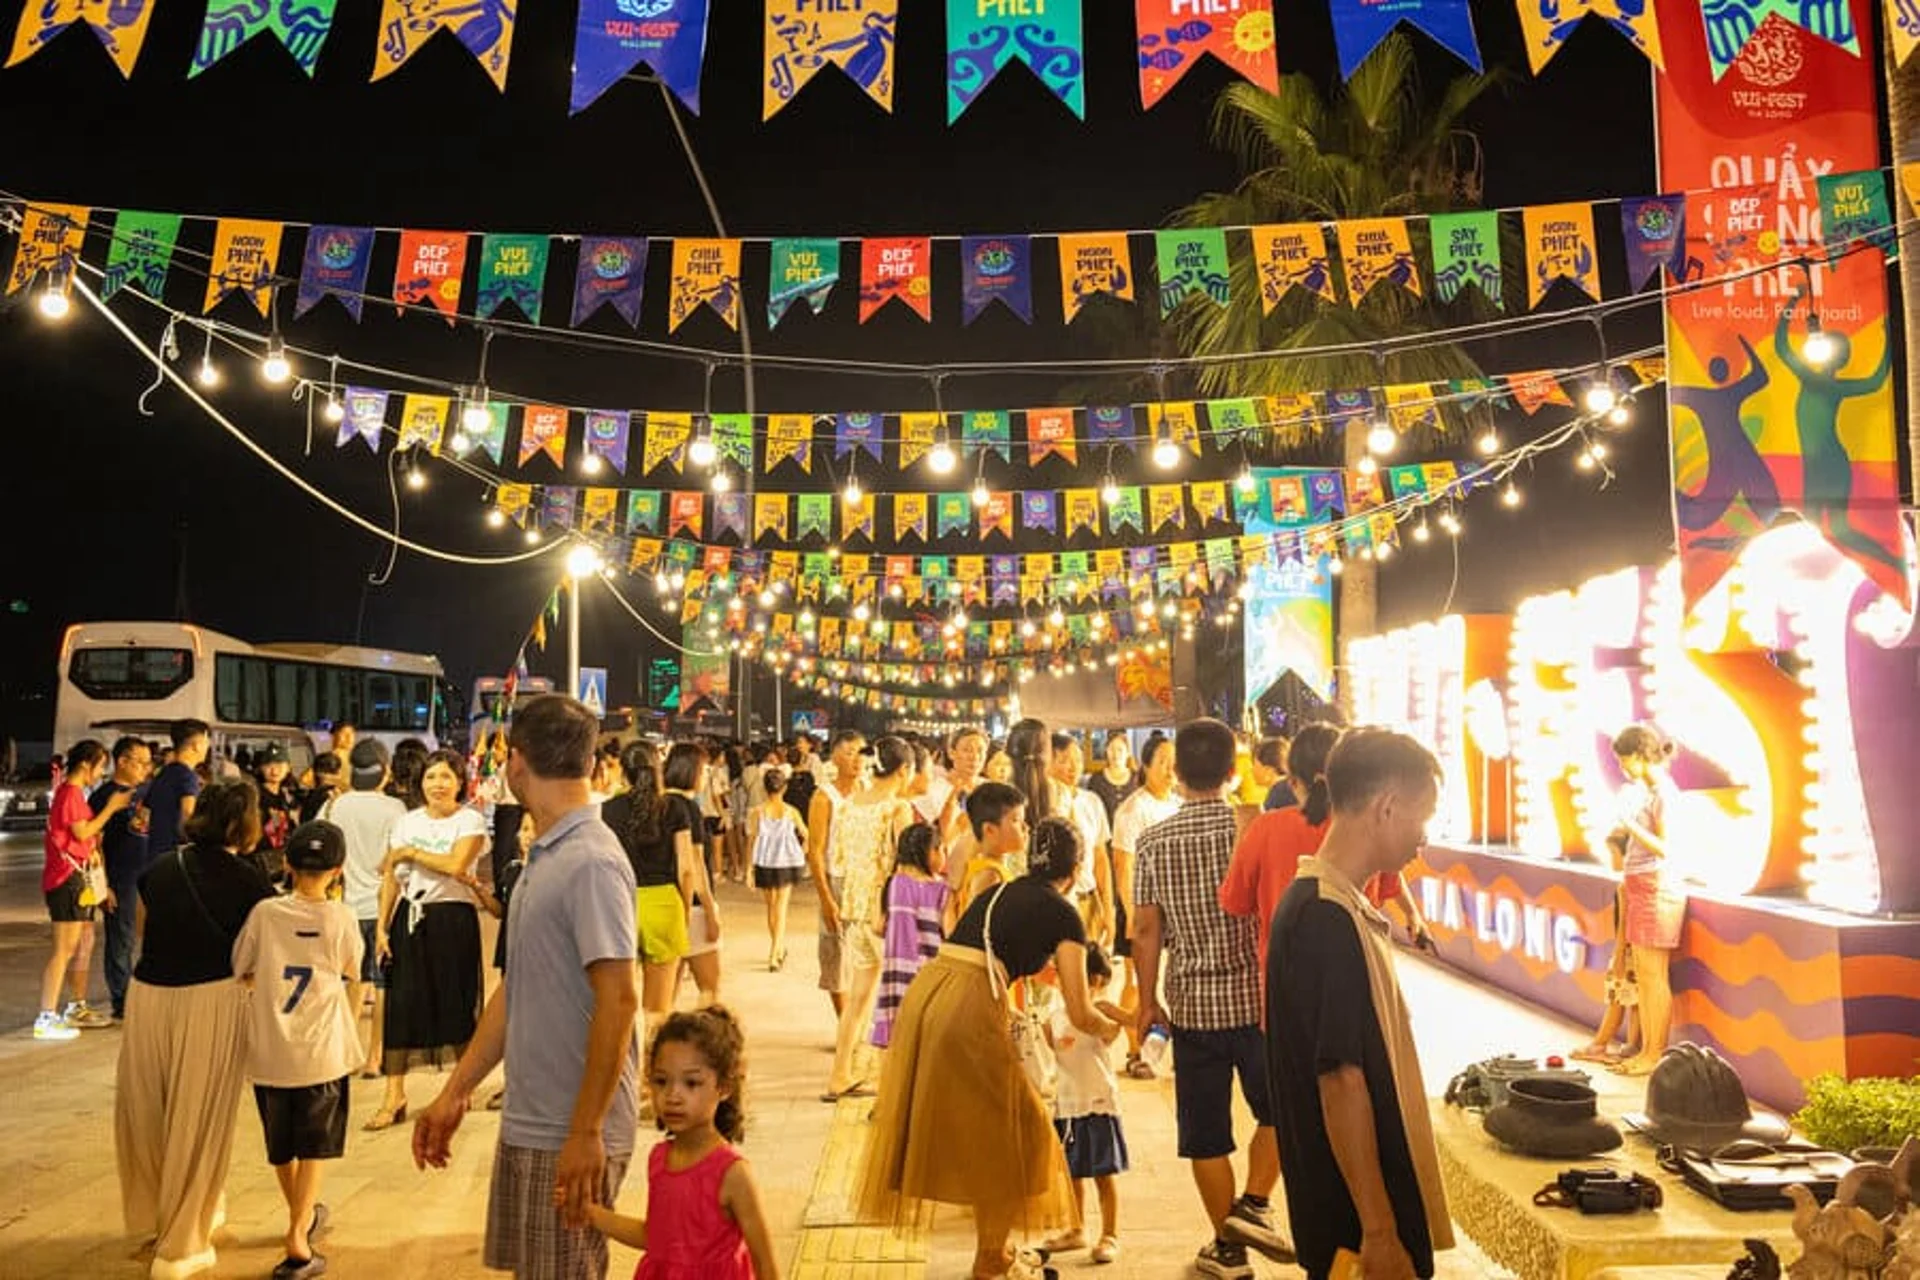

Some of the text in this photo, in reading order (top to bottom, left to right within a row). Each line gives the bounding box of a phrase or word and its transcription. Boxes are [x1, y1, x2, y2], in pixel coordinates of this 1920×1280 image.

[1692, 301, 1723, 318] Live
[1475, 890, 1588, 974] LONG
[282, 965, 313, 1014] 7
